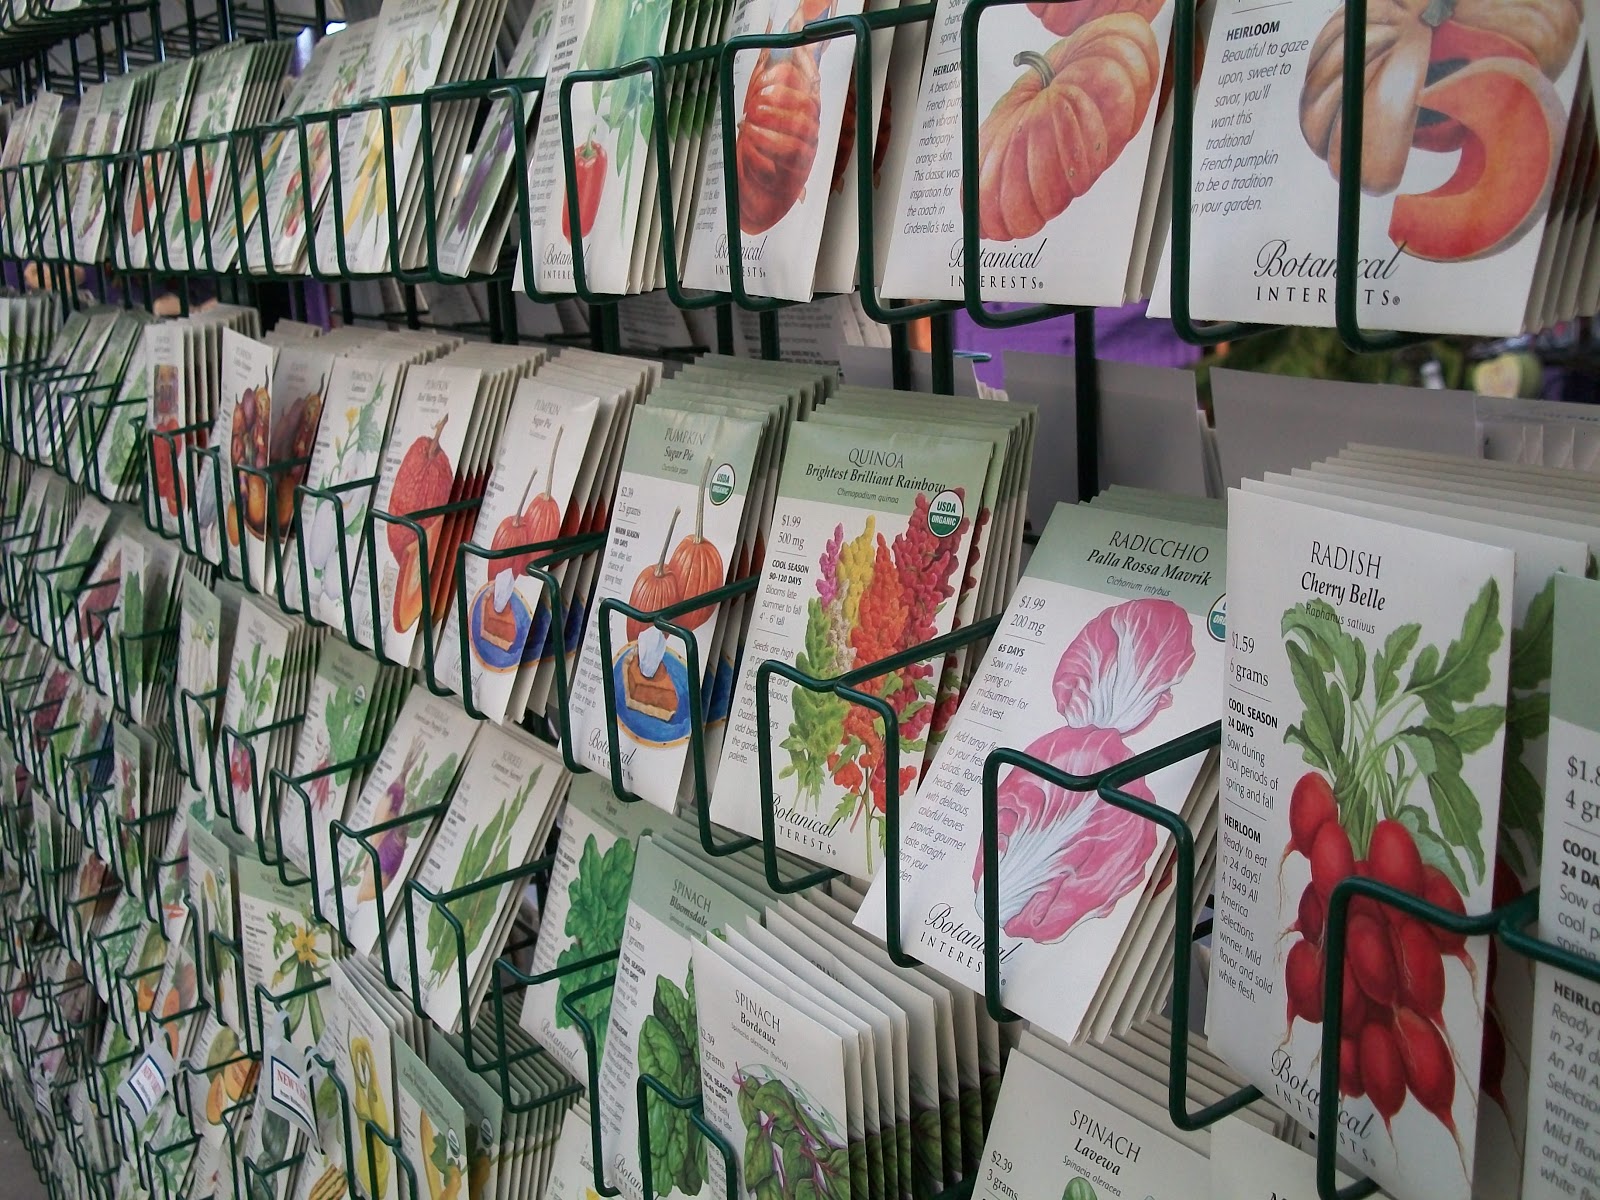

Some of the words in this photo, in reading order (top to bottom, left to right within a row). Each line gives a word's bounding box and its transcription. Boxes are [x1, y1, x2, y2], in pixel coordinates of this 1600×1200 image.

[1226, 20, 1279, 41] HEIRLOOM
[1222, 43, 1265, 64] Beautiful
[1267, 42, 1277, 56] to
[1280, 39, 1308, 57] gaze
[932, 61, 961, 77] HEIRLOO
[1218, 70, 1243, 88] upon,
[1247, 65, 1275, 81] sweet
[1279, 62, 1291, 76] to
[1214, 93, 1241, 108] savor,
[1243, 84, 1270, 103] you'll
[1210, 113, 1232, 128] want
[1235, 109, 1252, 125] this
[919, 134, 954, 148] mahogany-
[1206, 131, 1254, 149] traditional
[914, 170, 924, 181] This
[925, 168, 944, 180] classic
[946, 169, 960, 178] was
[1200, 154, 1232, 171] French
[1232, 151, 1278, 172] pumpkin
[910, 187, 941, 200] inspiration
[942, 187, 953, 197] for
[1195, 178, 1204, 193] to
[1206, 176, 1219, 191] be
[1222, 179, 1228, 190] a
[1230, 174, 1272, 189] tradition
[1199, 201, 1221, 216] your
[1223, 197, 1261, 215] garden.
[904, 221, 940, 235] Cinderella's
[940, 220, 955, 232] tale.
[949, 238, 1047, 269] Btanical
[1254, 239, 1407, 279] Botancal
[665, 428, 705, 446] PUMPKIN
[664, 446, 681, 462] Sugar
[683, 448, 694, 461] Pie
[849, 448, 904, 469] QUINOA
[717, 473, 730, 484] USDA
[806, 463, 848, 481] Brightest
[850, 468, 894, 487] Brilliant
[895, 474, 945, 492] Rainbow
[621, 486, 634, 498] $2.39
[837, 487, 877, 501] Chenopodium
[879, 493, 899, 504] quinoa
[626, 505, 641, 517] grams
[937, 501, 956, 513] USDA
[782, 514, 801, 527] $1.99
[931, 515, 956, 526] ORGANIC
[1109, 531, 1208, 563] RADICCHIO
[1311, 541, 1382, 579] RADISH
[772, 559, 787, 570] COOL
[788, 562, 809, 574] SEASON
[1086, 549, 1120, 568] Palla
[1122, 556, 1159, 575] Rossa
[1161, 564, 1212, 586] Mavrik
[1019, 595, 1046, 610] $1.99
[1144, 583, 1171, 597] intybus
[1301, 572, 1345, 606] Cherry
[1350, 584, 1385, 610] Belle
[1010, 614, 1026, 628] 200
[1028, 621, 1045, 636] mg
[1305, 603, 1344, 625] Raphanus
[1347, 618, 1375, 634] sativus
[998, 643, 1006, 653] 65
[1007, 646, 1025, 657] DAYS
[1236, 663, 1269, 686] grams
[1228, 698, 1245, 716] COOL
[1247, 707, 1278, 729] SEASON
[1228, 716, 1234, 728] 24
[1236, 722, 1254, 738] DAYS
[1227, 734, 1240, 750] Sow
[1242, 742, 1265, 767] during
[1226, 756, 1239, 771] cool
[1241, 764, 1267, 787] periods
[1270, 778, 1278, 791] of
[1226, 776, 1244, 798] spring
[1247, 788, 1260, 804] and
[1262, 793, 1274, 810] fall
[1565, 790, 1576, 809] 4
[918, 804, 941, 821] colorful
[942, 812, 964, 832] leaves
[1224, 813, 1260, 844] HEIRLOOM
[904, 835, 919, 849] taste
[921, 843, 946, 861] straight
[910, 821, 934, 838] provide
[935, 833, 966, 851] gourmet
[1224, 832, 1243, 857] Ready
[1245, 844, 1252, 859] to
[1254, 852, 1267, 868] eat
[1562, 839, 1599, 866] COOL
[1223, 854, 1228, 865] in
[1230, 856, 1239, 871] 24
[1241, 864, 1261, 885] days!
[1561, 862, 1576, 879] 24
[673, 879, 712, 913] SPINACH
[1228, 876, 1247, 897] 1949
[1248, 889, 1258, 904] All
[1560, 884, 1588, 910] Sow
[669, 896, 708, 928] Bloomsdale
[1221, 891, 1248, 918] America
[925, 902, 1023, 964] Botanial
[1220, 910, 1254, 942] Selections
[1558, 912, 1585, 935] cool
[1220, 931, 1242, 953] winner.
[1245, 946, 1261, 966] Mild
[1220, 948, 1237, 969] flavor
[1239, 964, 1253, 980] and
[1255, 975, 1273, 994] solid
[1219, 969, 1236, 989] white
[1238, 981, 1256, 1003] flesh.
[736, 989, 781, 1032] SPINACH
[1553, 1003, 1593, 1038] Ready
[740, 1012, 777, 1046] Bordeaux
[705, 1051, 725, 1070] grams
[1548, 1051, 1564, 1071] An
[1569, 1063, 1586, 1083] All
[714, 1078, 733, 1097] SEASON
[1271, 1049, 1374, 1139] Botacal
[1545, 1098, 1589, 1131] winner
[1070, 1109, 1142, 1163] SPINACH
[991, 1150, 1013, 1174] $2.39
[1074, 1138, 1121, 1176] Lavewa
[1542, 1144, 1567, 1168] and
[987, 1169, 993, 1181] 3
[993, 1177, 1018, 1200] grams
[1063, 1155, 1090, 1179] Spinacia
[1092, 1175, 1121, 1197] oleracea
[1540, 1166, 1575, 1196] white
